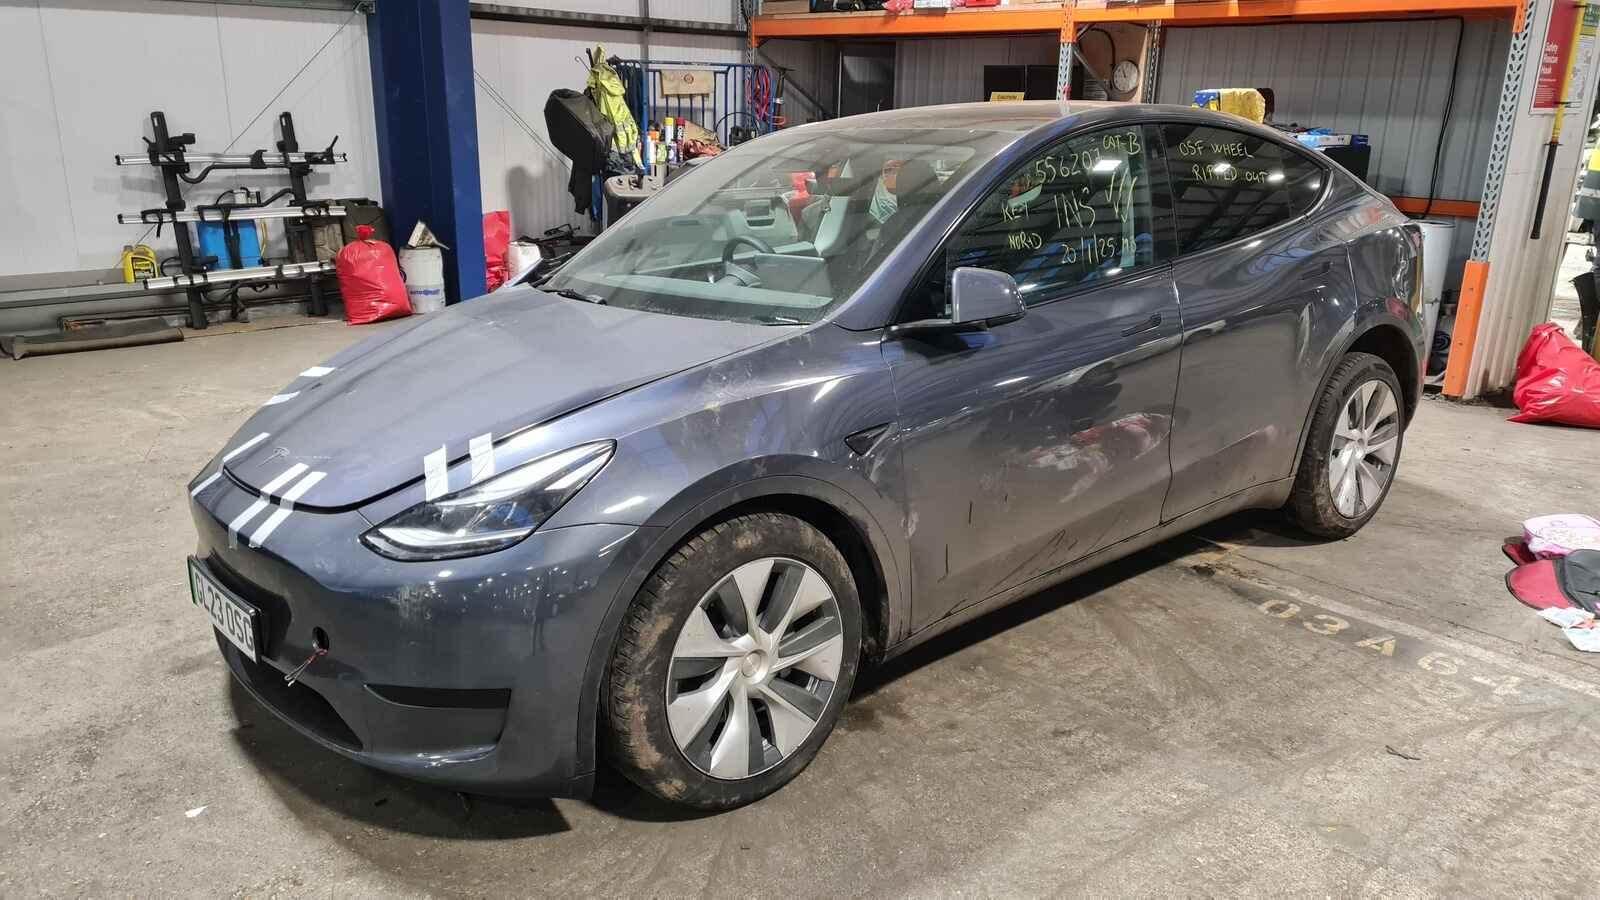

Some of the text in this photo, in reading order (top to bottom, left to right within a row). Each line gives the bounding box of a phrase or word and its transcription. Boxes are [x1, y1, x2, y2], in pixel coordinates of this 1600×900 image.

[1179, 140, 1255, 159] OSF WHEEL
[1245, 170, 1269, 184] OUT
[225, 601, 255, 653] OSG
